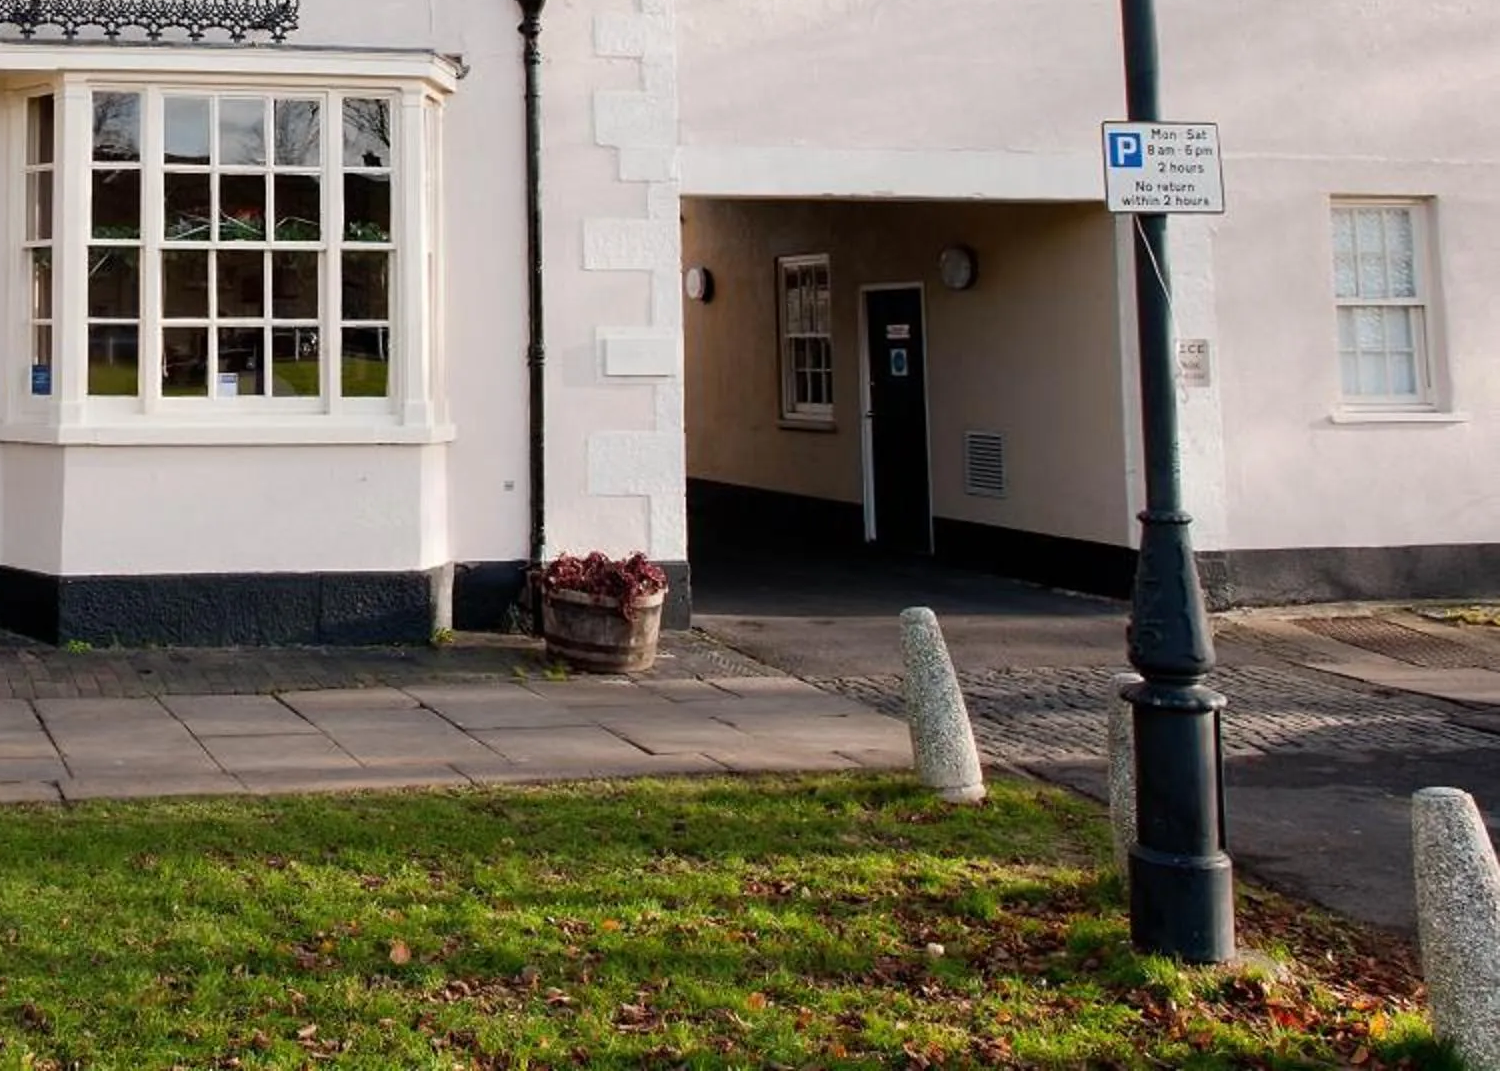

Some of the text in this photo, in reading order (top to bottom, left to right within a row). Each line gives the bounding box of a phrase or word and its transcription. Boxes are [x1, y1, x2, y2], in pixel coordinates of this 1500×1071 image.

[1151, 129, 1208, 141] Mon Sat
[1116, 136, 1137, 166] P
[1157, 162, 1205, 174] 2 hours
[1135, 181, 1195, 192] No return
[1121, 195, 1210, 206] within 2 hours
